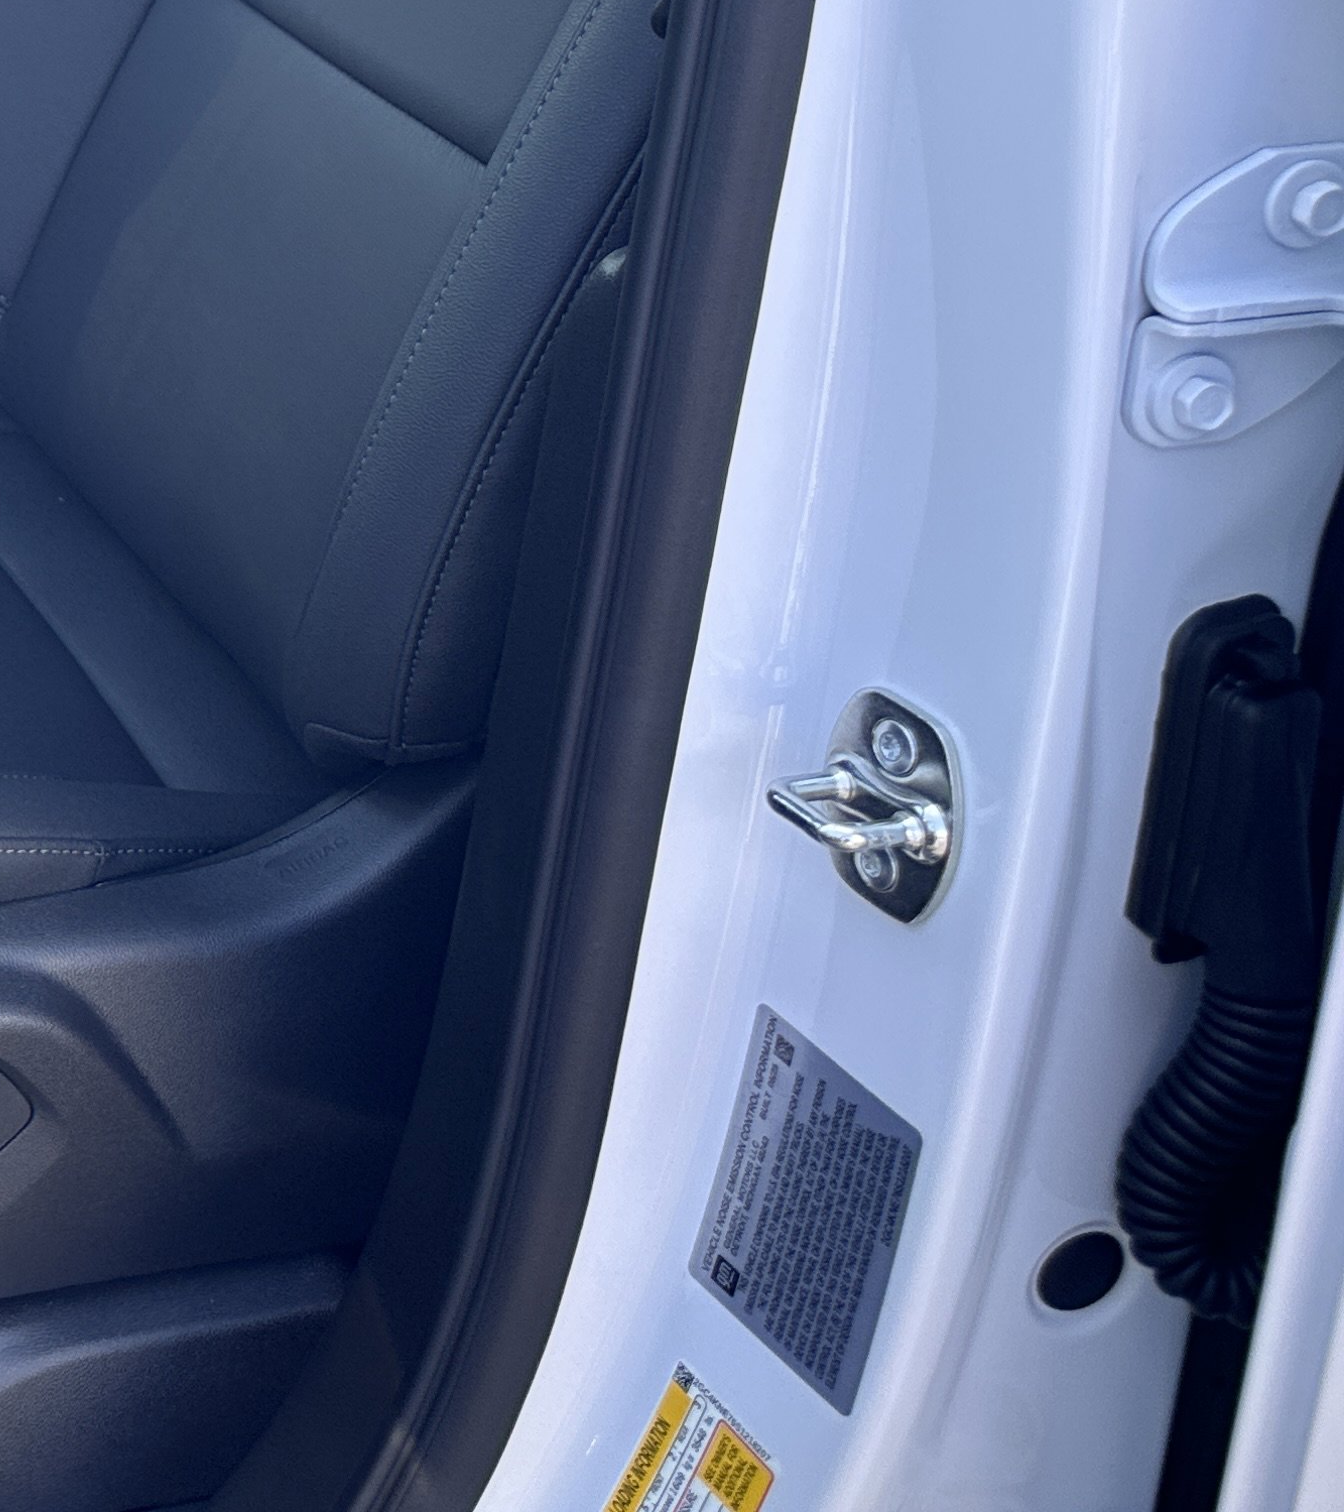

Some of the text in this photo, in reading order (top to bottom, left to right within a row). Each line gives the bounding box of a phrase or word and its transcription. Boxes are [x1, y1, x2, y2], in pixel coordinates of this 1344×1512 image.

[702, 1225, 722, 1274] VEHICLE
[716, 1191, 732, 1228] NOISE
[725, 1140, 746, 1194] EMISSION
[739, 1088, 760, 1142] CONTROL
[752, 1015, 778, 1088] INFORMATION
[630, 1414, 670, 1481] INFORMATION
